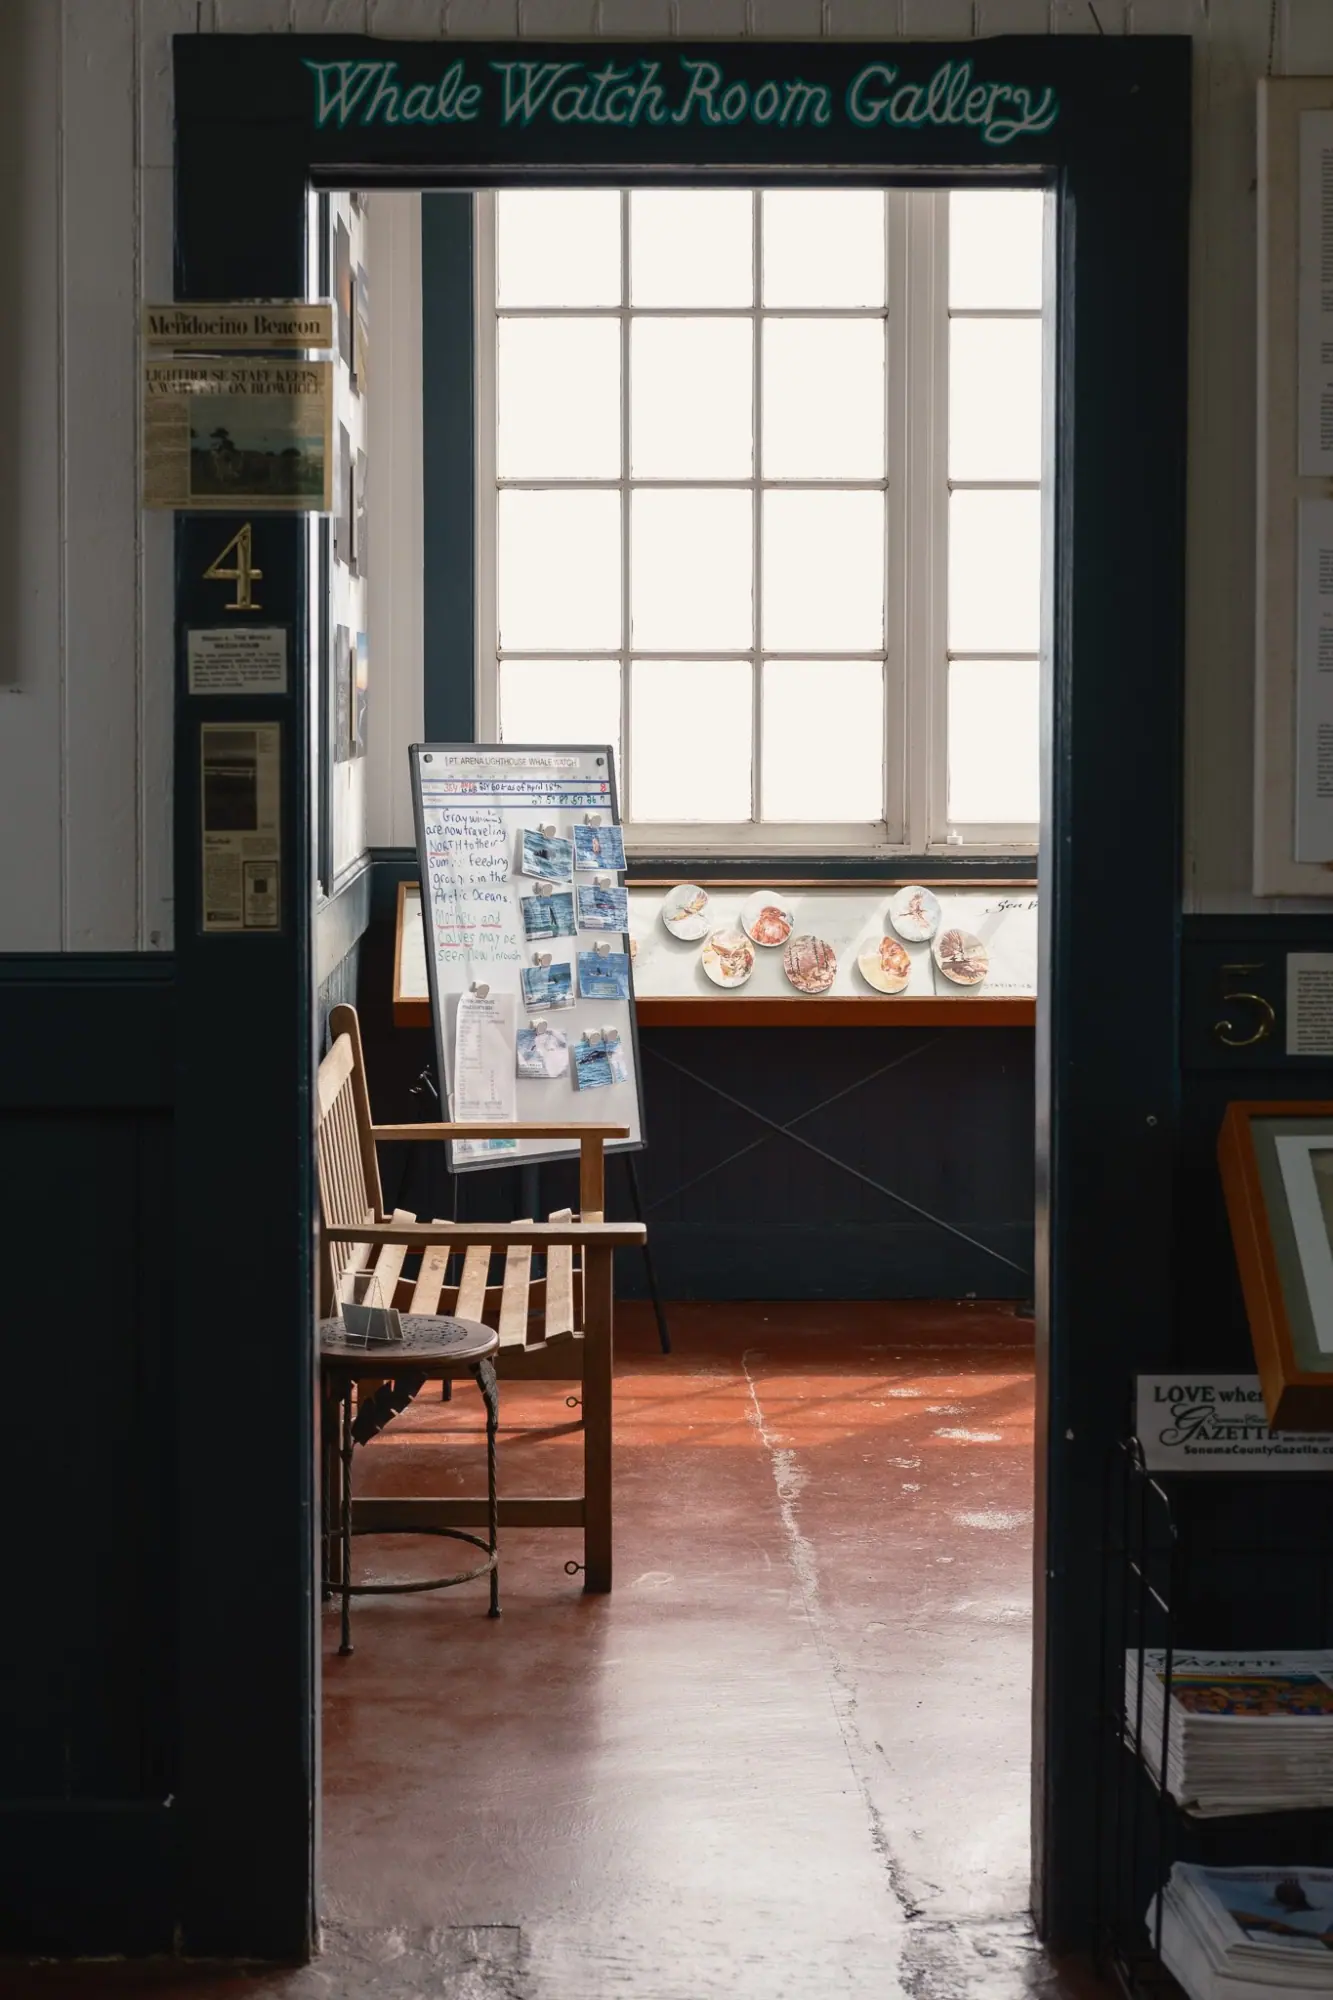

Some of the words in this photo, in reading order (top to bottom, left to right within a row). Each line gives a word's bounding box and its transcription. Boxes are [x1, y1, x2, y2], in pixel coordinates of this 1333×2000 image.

[304, 60, 483, 129] Whale
[491, 60, 666, 128] Watch
[674, 54, 832, 127] Room
[846, 57, 1061, 146] Gallery
[149, 314, 248, 335] Mendocino
[253, 315, 321, 336] Beacon
[145, 369, 229, 382] LIGHTHOUSE
[231, 369, 274, 382] STAFF
[276, 369, 318, 383] KEEPS
[228, 382, 248, 395] ON
[202, 521, 263, 609] 4
[442, 808, 468, 826] Gray
[426, 825, 443, 836] are
[444, 825, 463, 836] now
[463, 824, 507, 842] traveling
[489, 870, 508, 883] the
[1214, 962, 1276, 1047] 5
[1154, 1386, 1216, 1403] LOVE
[1159, 1403, 1280, 1447] GAZETTE
